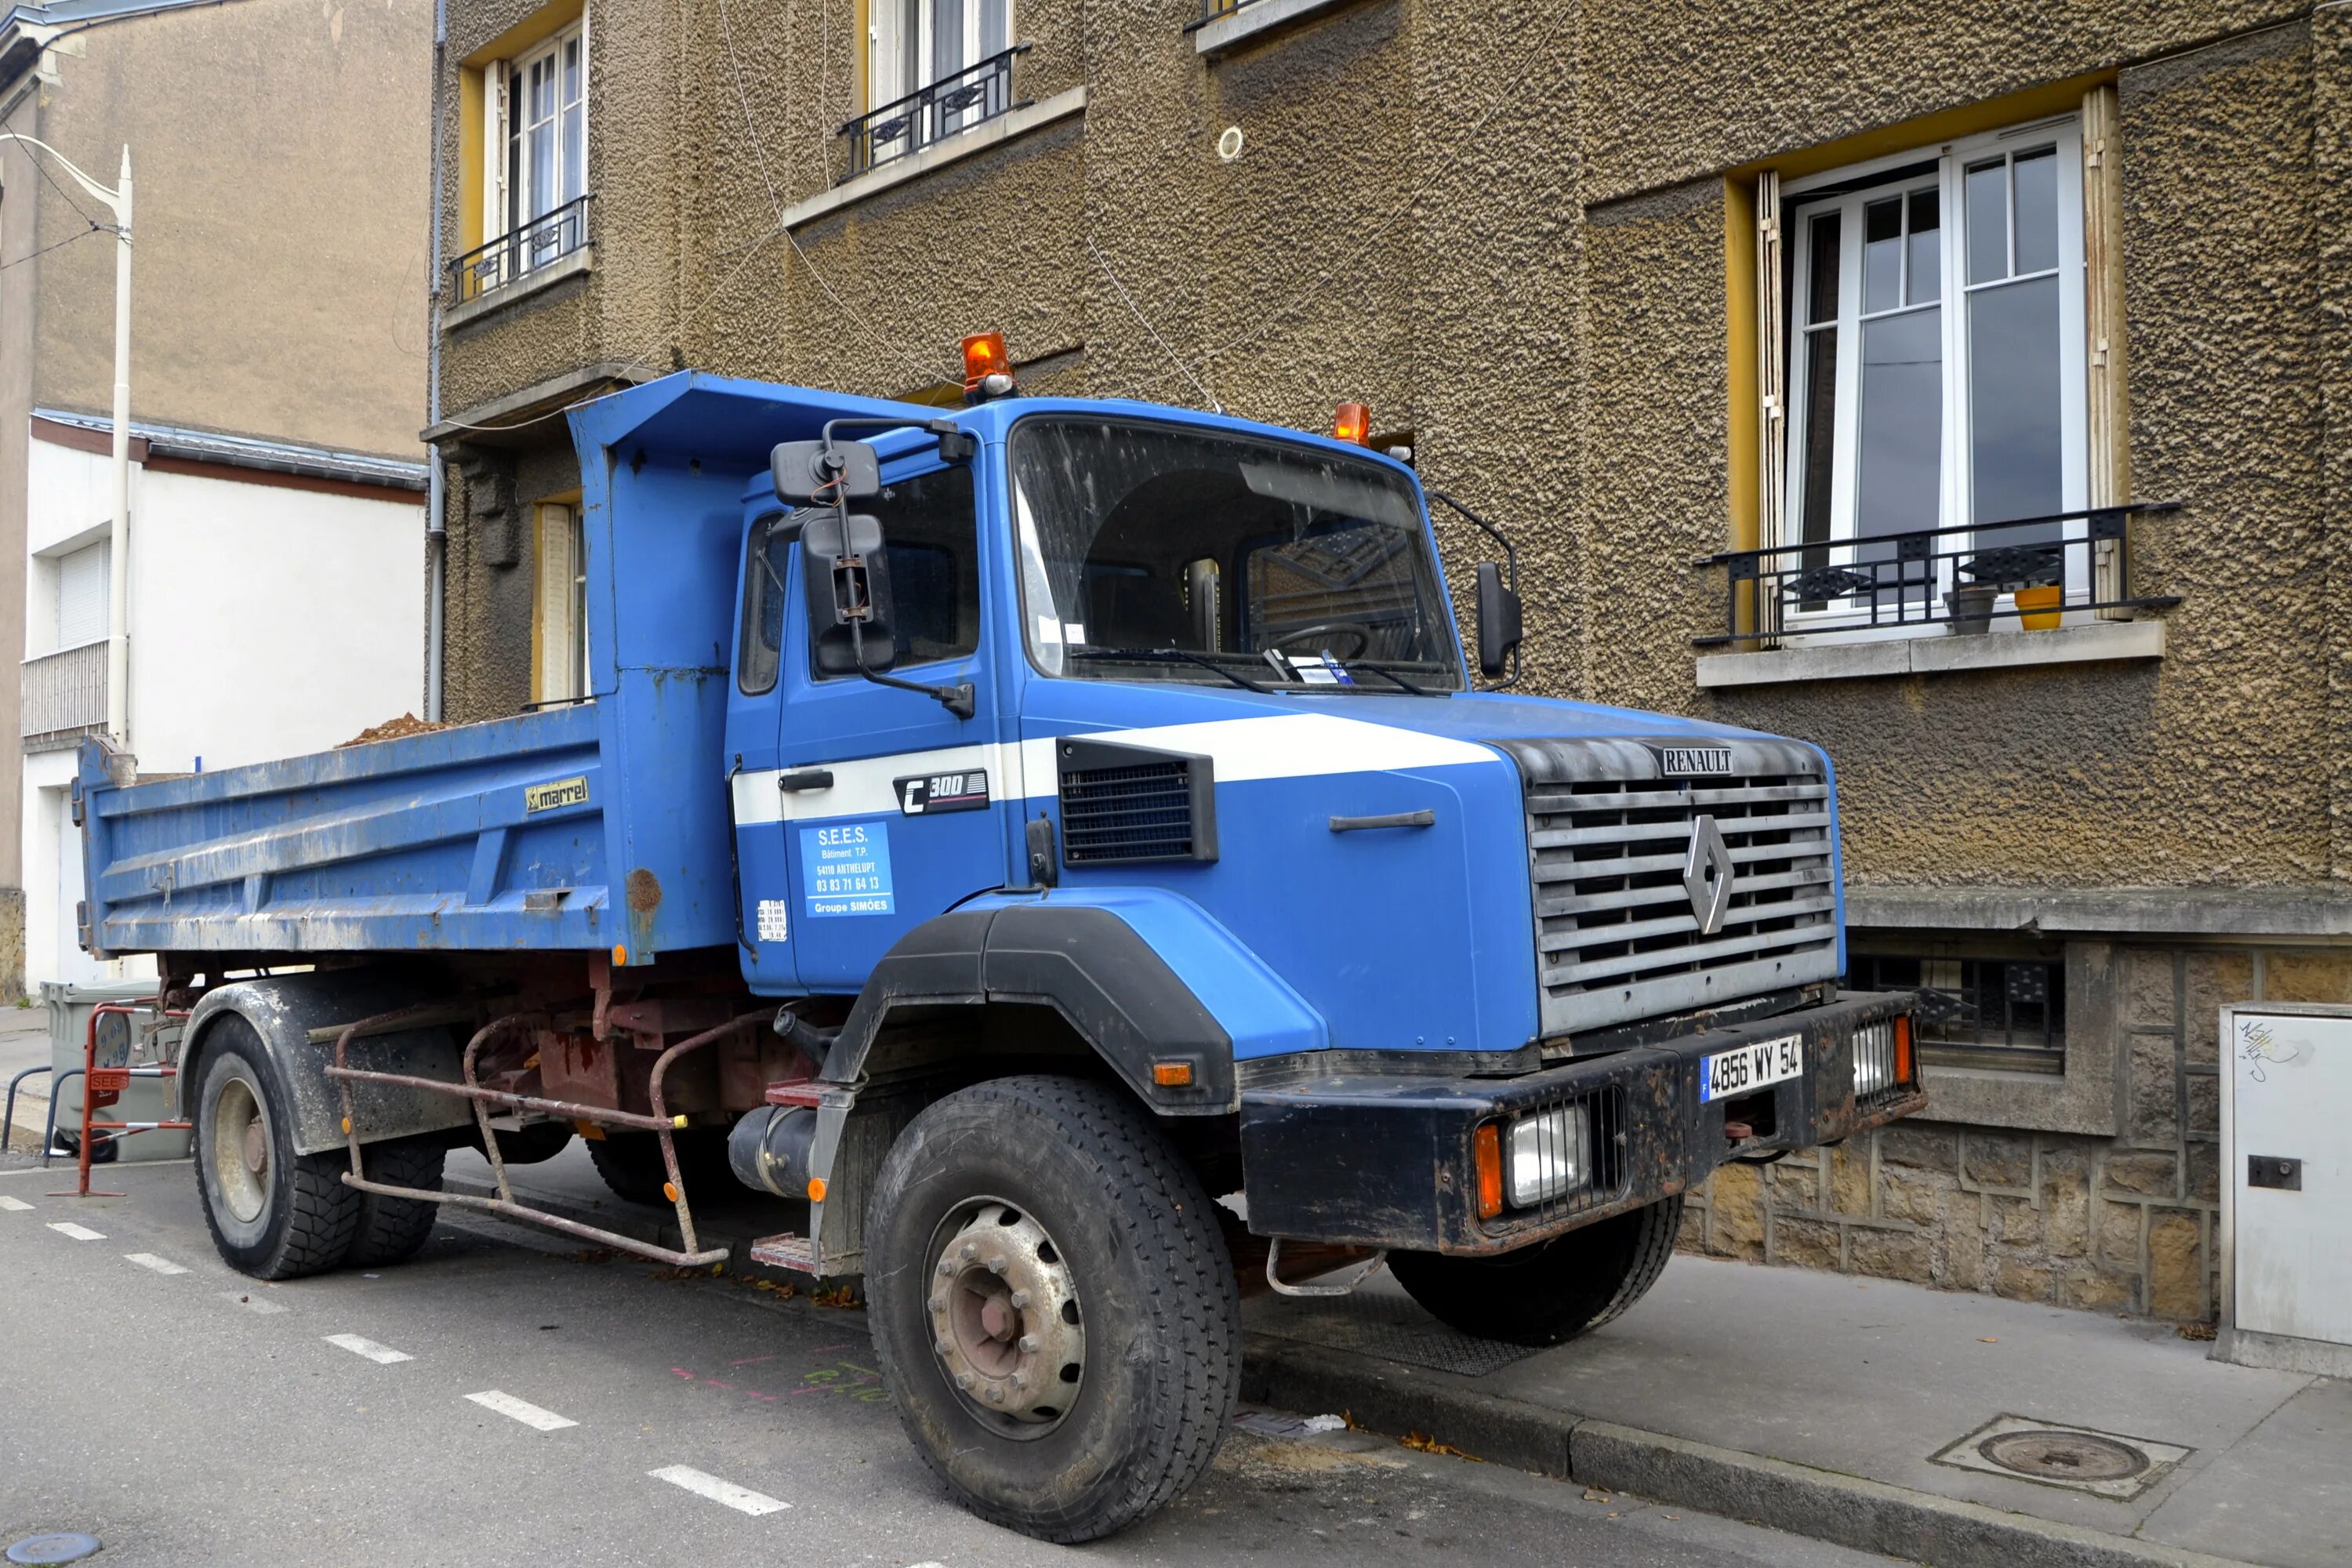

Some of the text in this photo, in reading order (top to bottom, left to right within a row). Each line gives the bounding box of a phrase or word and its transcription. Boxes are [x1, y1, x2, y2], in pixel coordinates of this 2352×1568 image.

[1664, 750, 1732, 772] RENAULT
[539, 779, 586, 807] marrel
[904, 775, 963, 813] C 300
[818, 826, 869, 846] S.E.E.S.
[817, 862, 875, 876] 54110 ANTHELUPT
[816, 877, 879, 892] 03 83 71 64 13
[815, 902, 848, 913] Groupe
[1711, 1052, 1748, 1093] 4856
[1755, 1046, 1773, 1082] WY
[1780, 1040, 1798, 1075] 54
[93, 1076, 129, 1088] SEES
